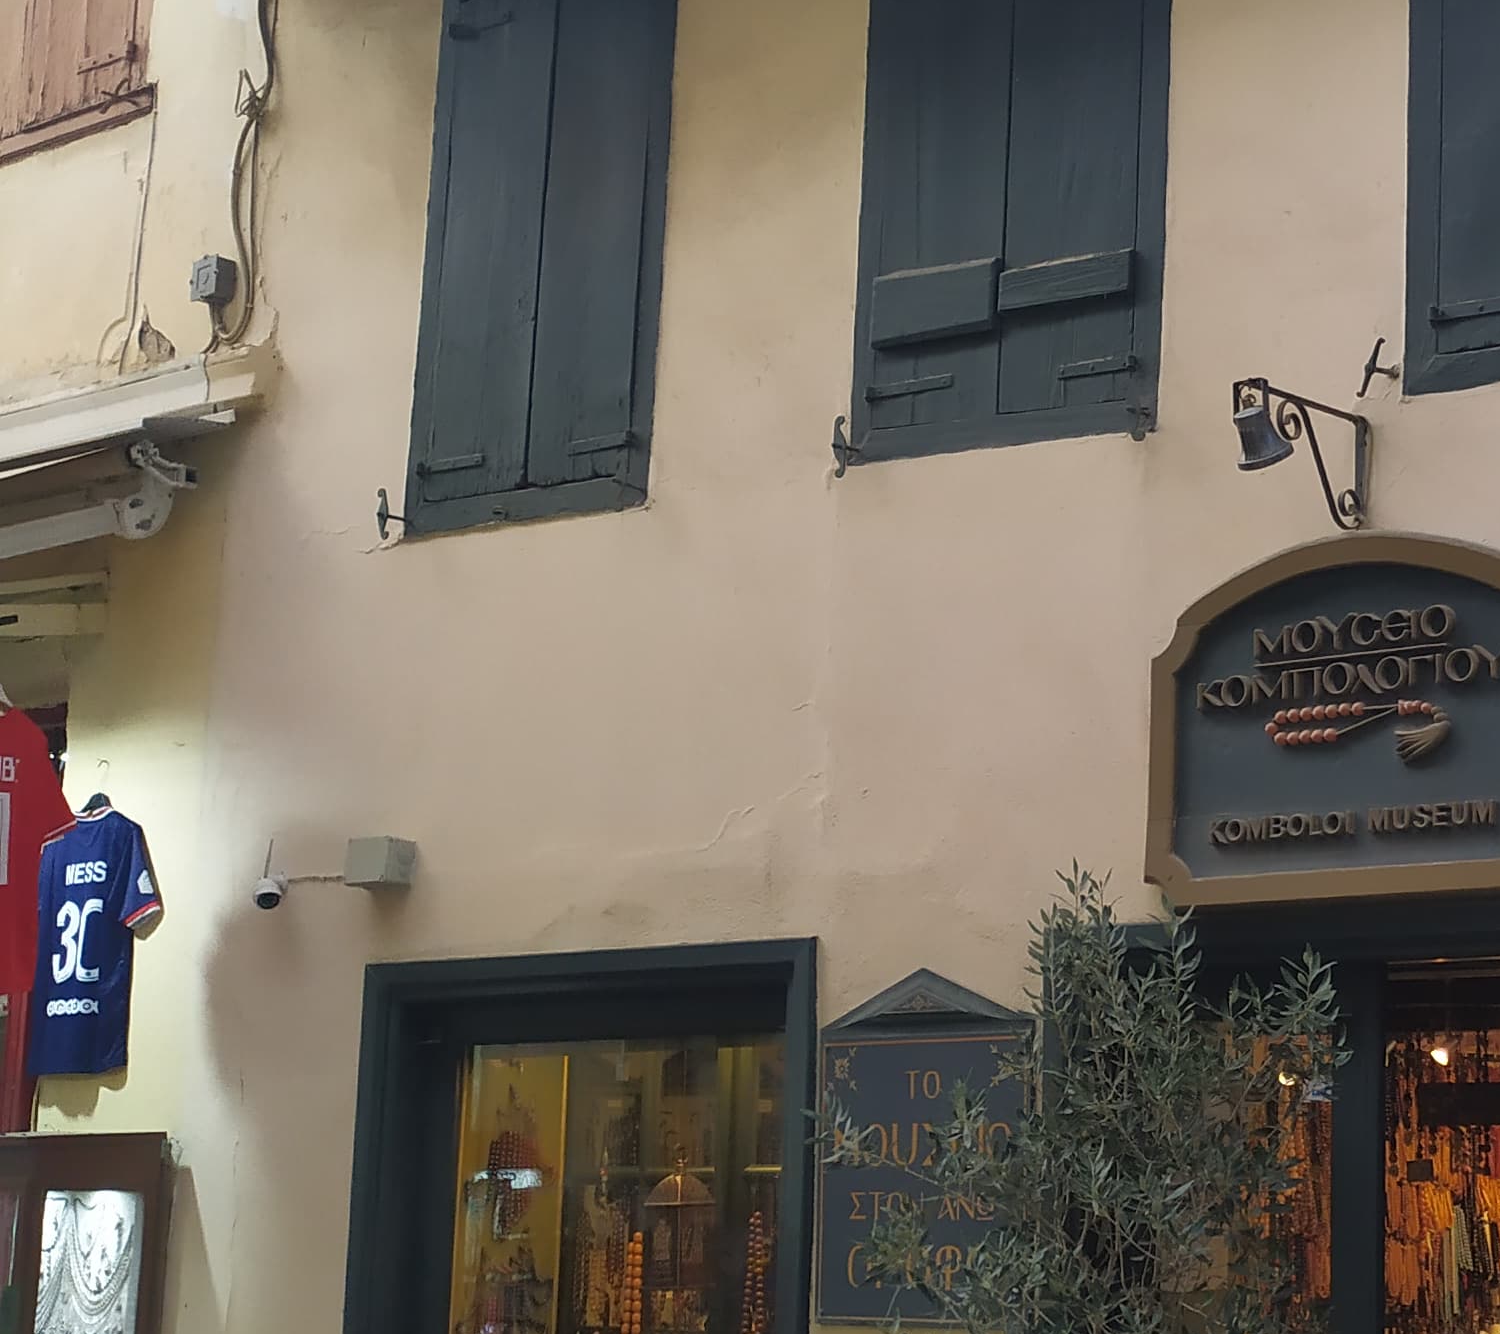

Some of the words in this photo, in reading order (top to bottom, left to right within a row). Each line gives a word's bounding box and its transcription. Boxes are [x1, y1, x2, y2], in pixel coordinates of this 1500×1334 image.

[1209, 810, 1357, 846] KOMBOLOI
[1367, 799, 1500, 833] MUSEUM
[905, 1070, 942, 1099] ΤΟ
